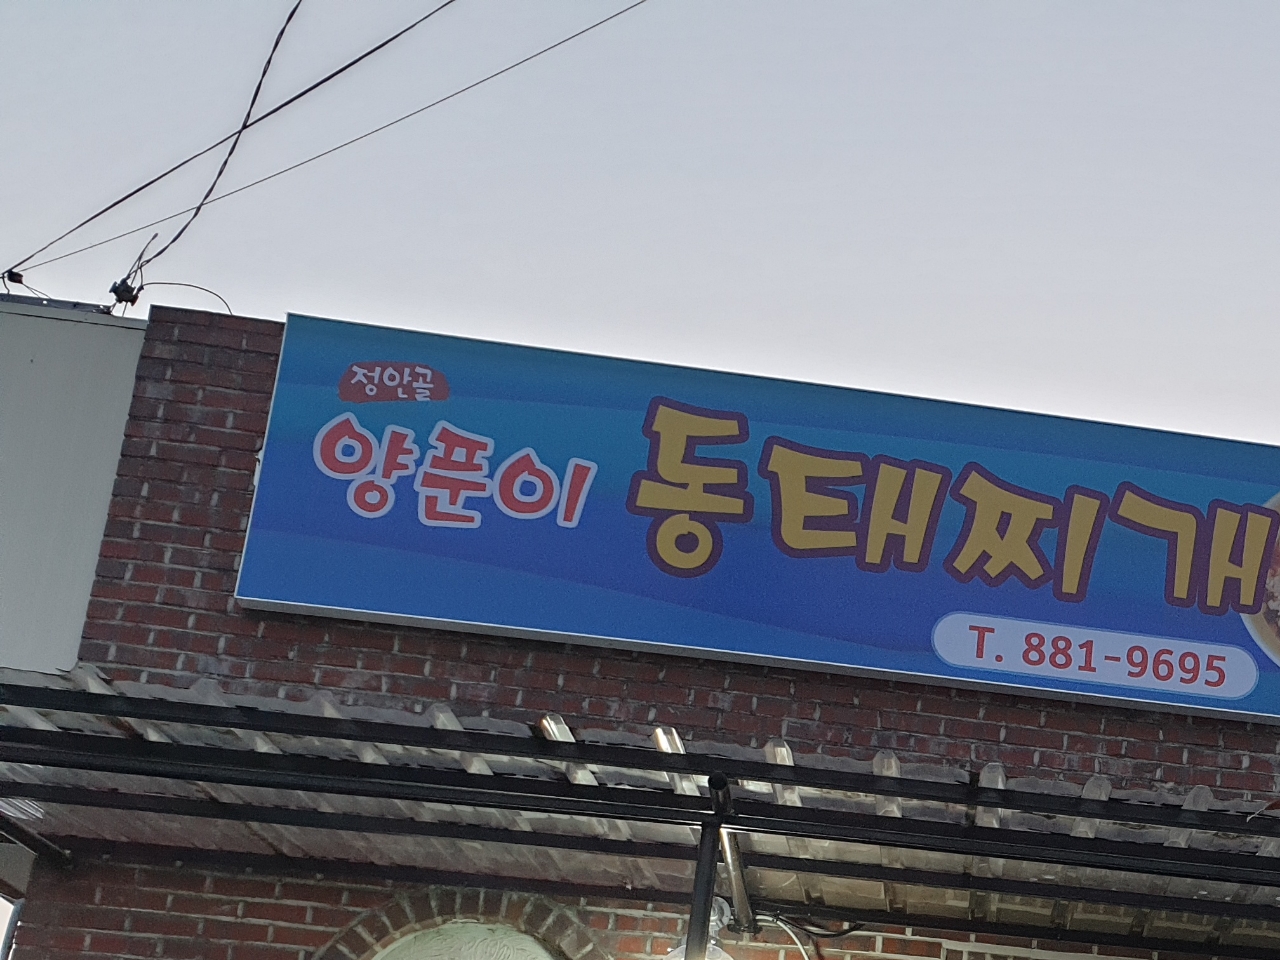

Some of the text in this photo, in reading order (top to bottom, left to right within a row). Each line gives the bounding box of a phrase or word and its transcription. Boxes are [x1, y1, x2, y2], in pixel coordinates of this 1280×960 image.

[350, 364, 435, 402] 정안골
[314, 412, 597, 529] 양푼이
[627, 396, 1280, 616] 동태찌개
[968, 625, 1227, 688] T. 881-9695
